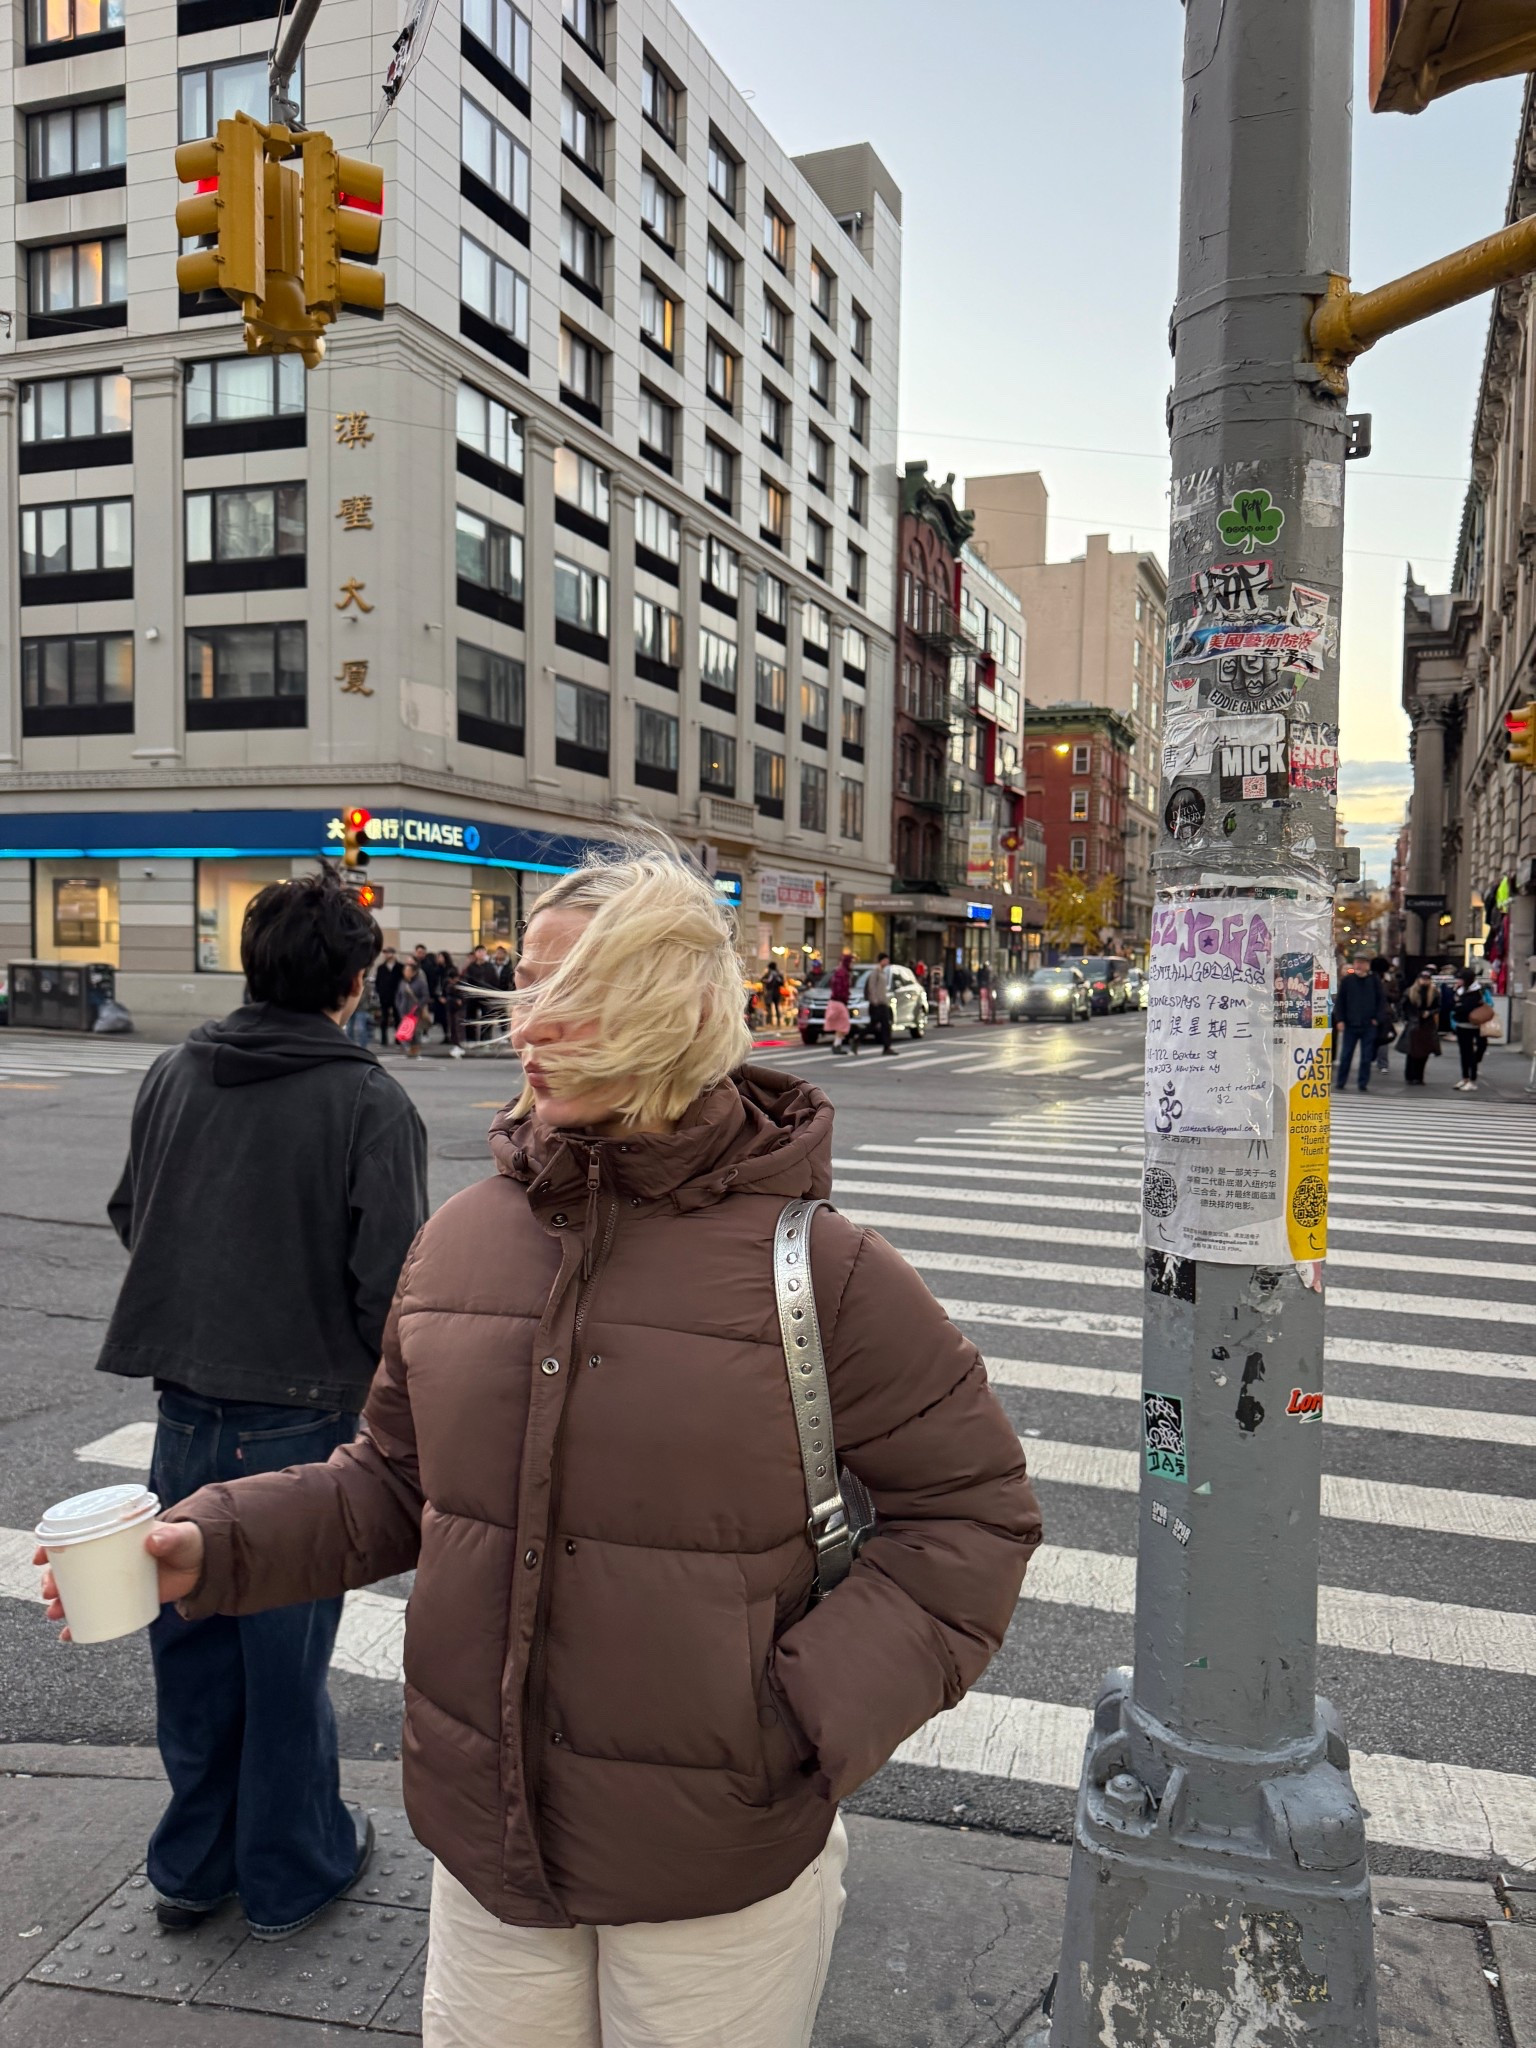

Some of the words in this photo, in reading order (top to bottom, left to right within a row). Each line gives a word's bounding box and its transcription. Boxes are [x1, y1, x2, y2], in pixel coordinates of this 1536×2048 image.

[1210, 689, 1238, 711] EDDIE
[1221, 743, 1286, 777] MICK
[404, 819, 464, 847] CHASE
[1179, 908, 1272, 971] YOGA
[1207, 1083, 1231, 1093] mat
[1235, 1081, 1266, 1091] rental
[1290, 1111, 1323, 1122] Looking
[1290, 1125, 1317, 1134] actors
